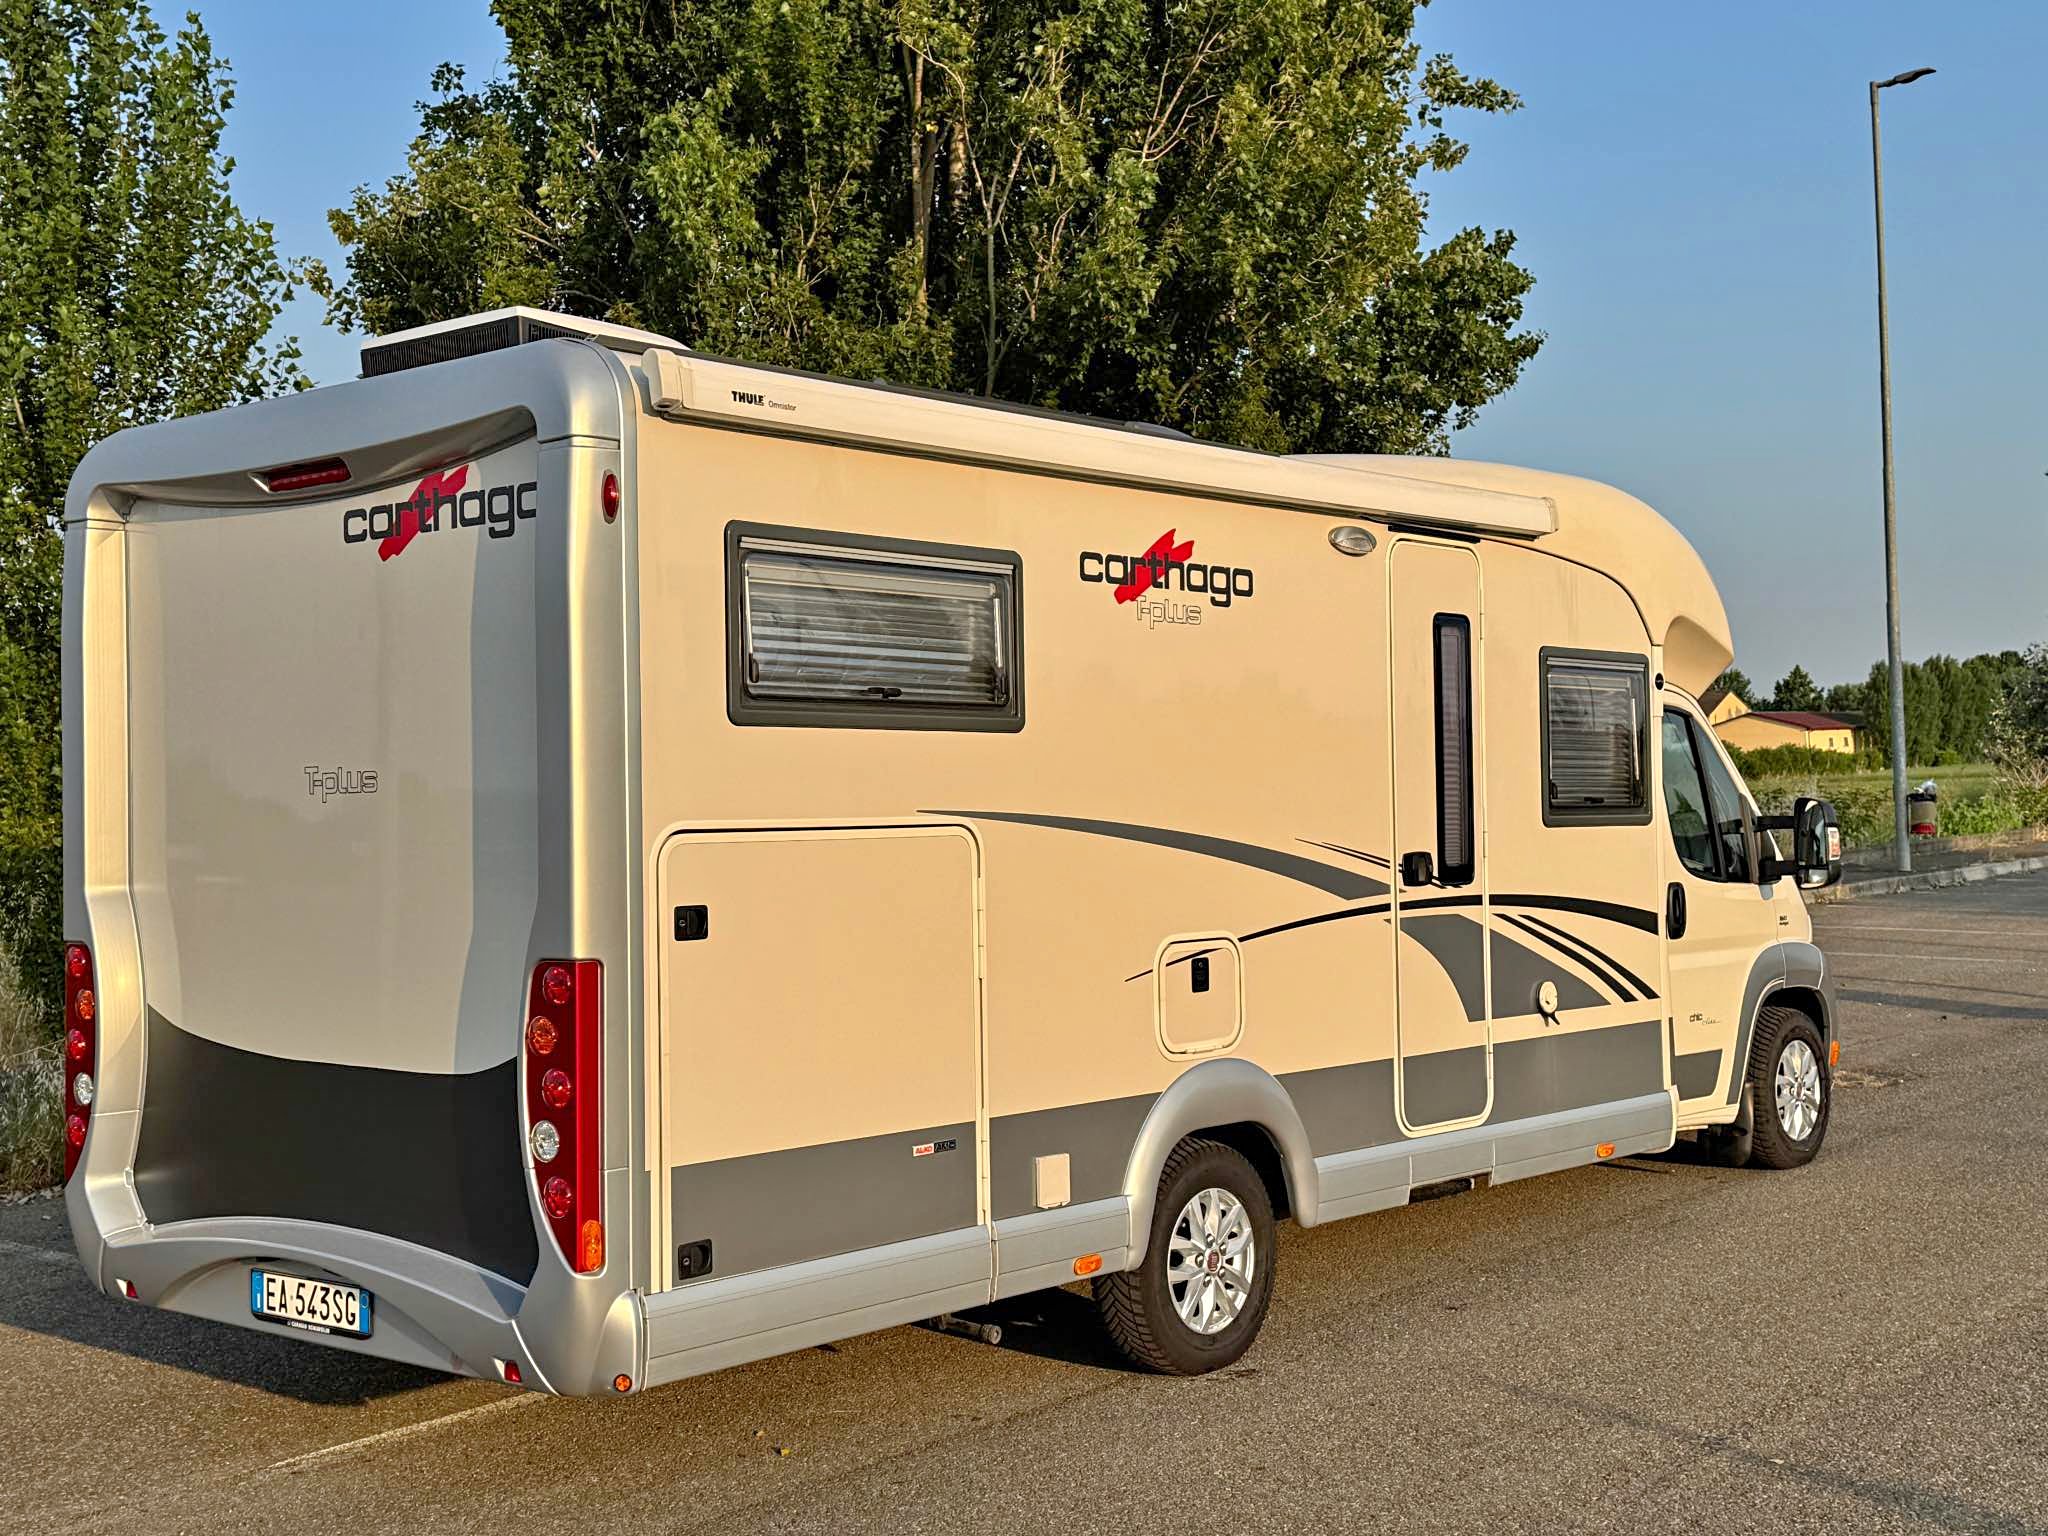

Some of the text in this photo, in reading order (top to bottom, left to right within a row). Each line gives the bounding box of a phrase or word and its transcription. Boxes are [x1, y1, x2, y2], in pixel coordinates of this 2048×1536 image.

[731, 390, 765, 407] THULE
[1079, 550, 1254, 608] carthago
[1134, 594, 1202, 630] T-plus
[303, 765, 379, 804] T-plus
[265, 1277, 289, 1314] EA
[295, 1282, 358, 1326] 543SG
